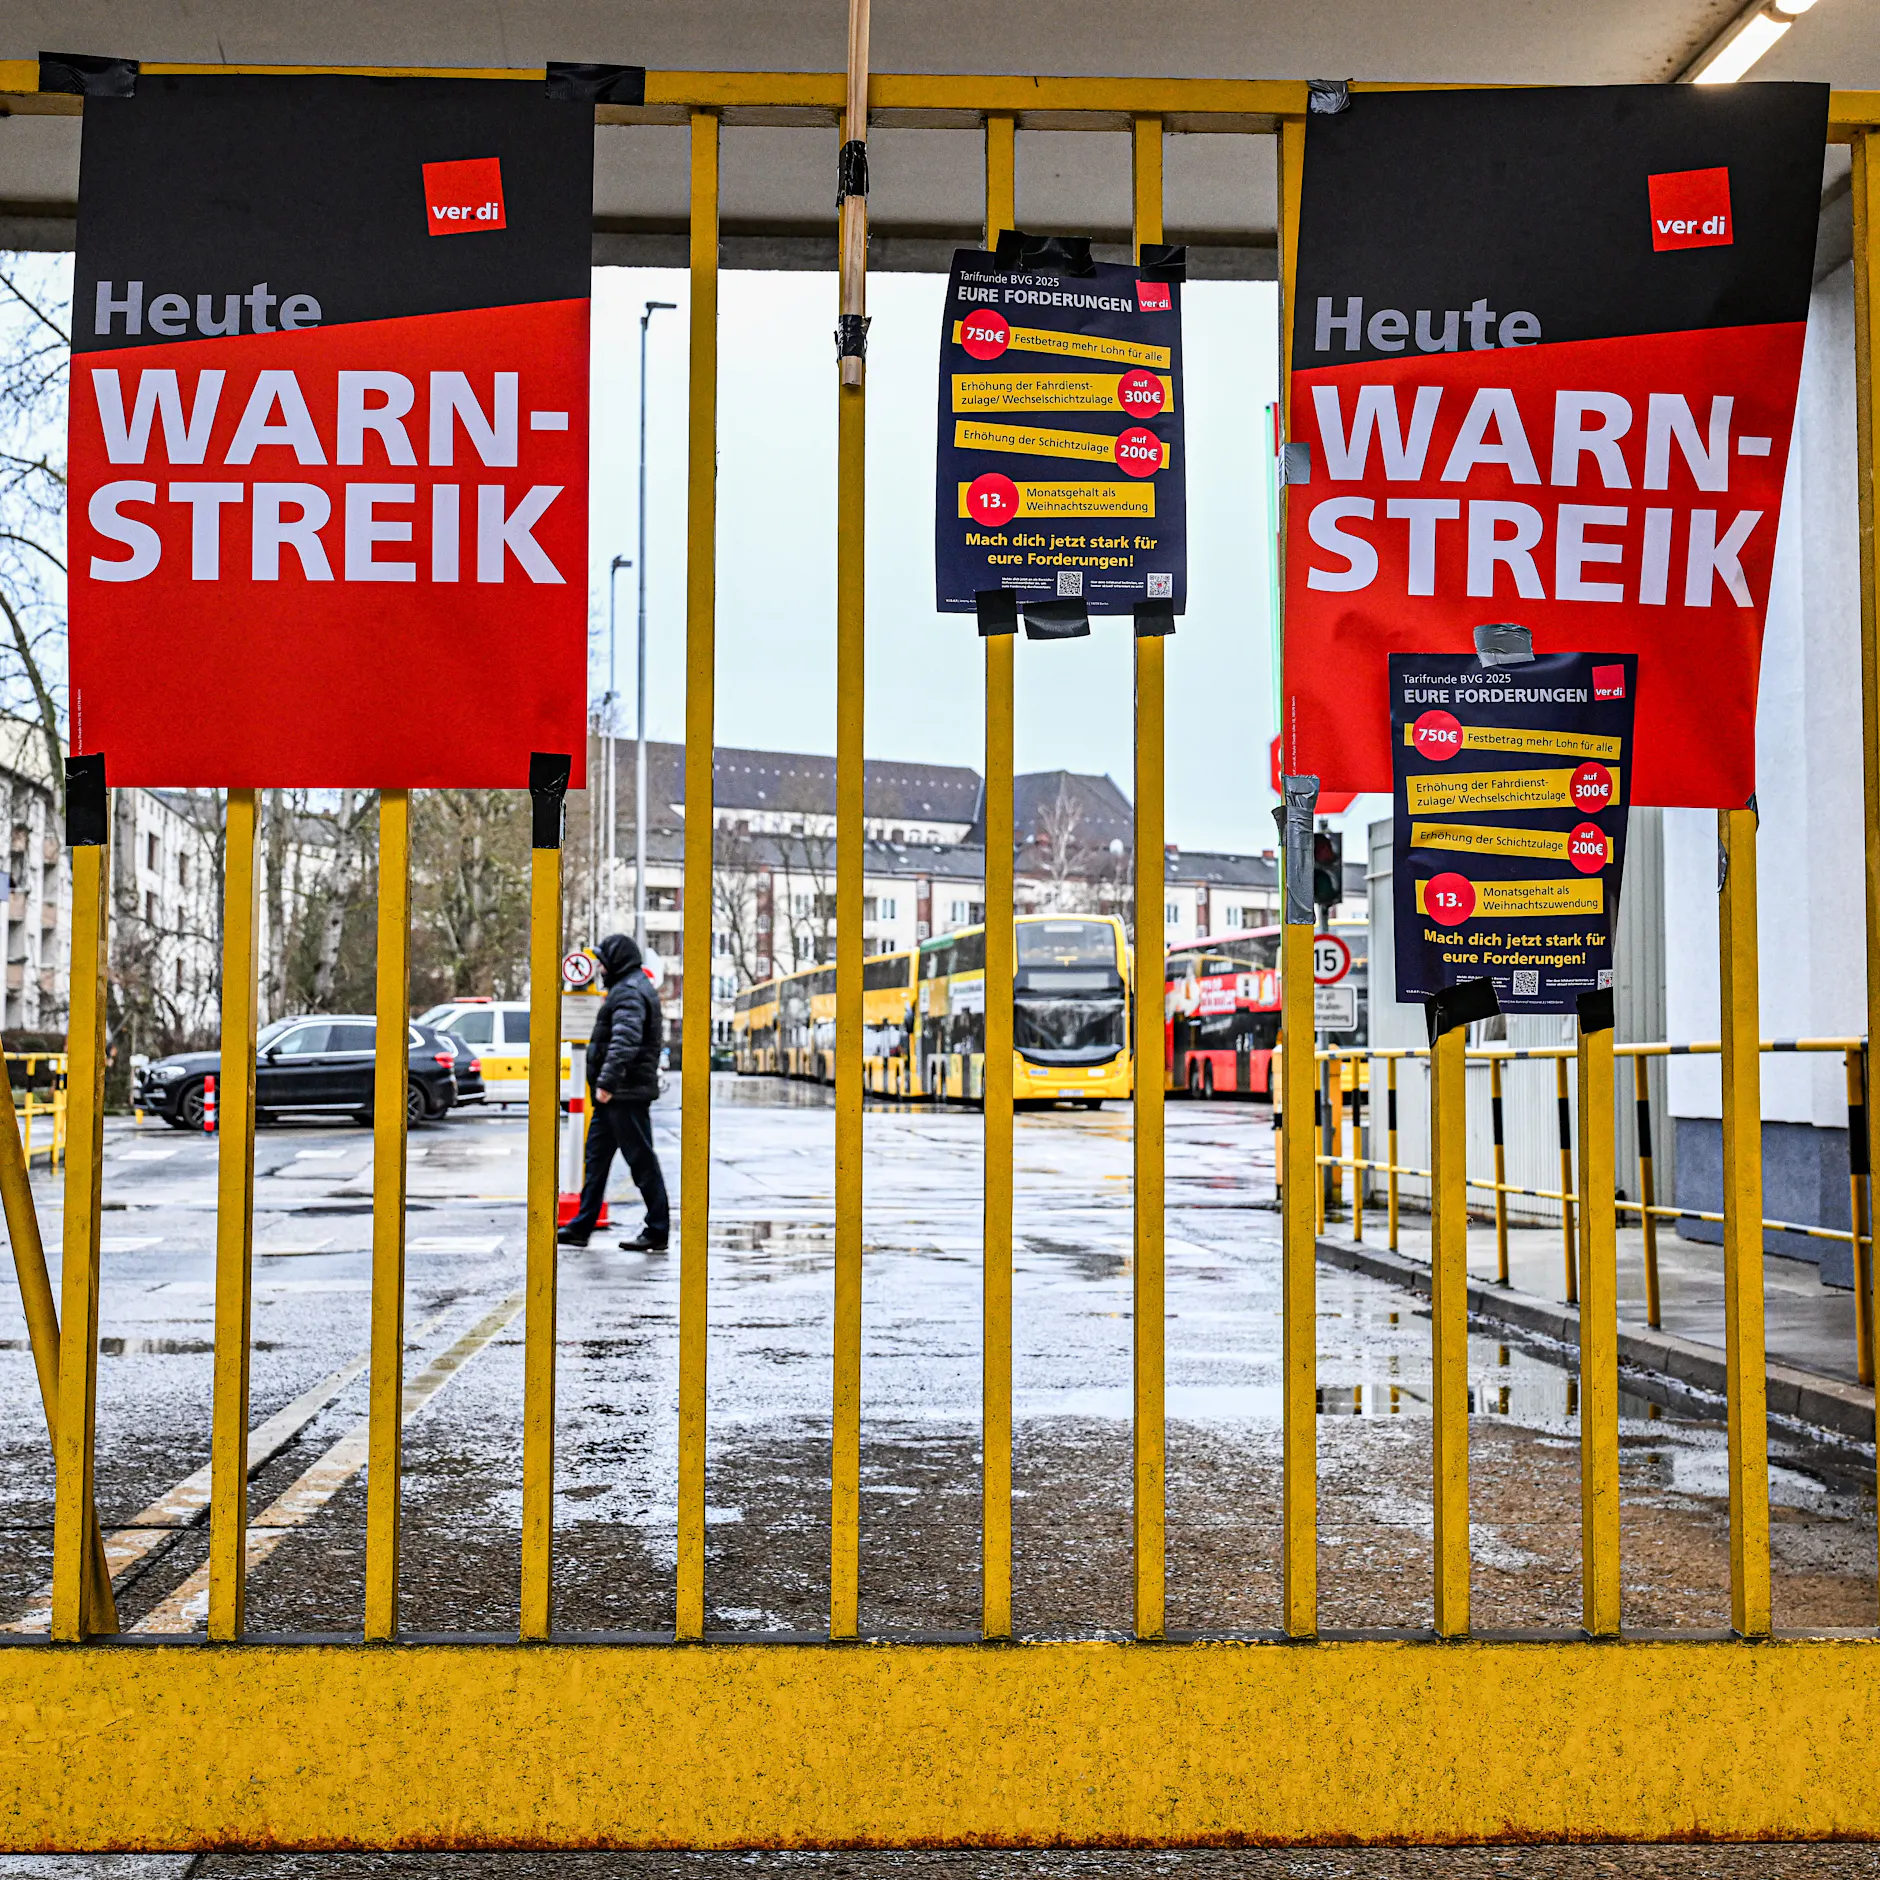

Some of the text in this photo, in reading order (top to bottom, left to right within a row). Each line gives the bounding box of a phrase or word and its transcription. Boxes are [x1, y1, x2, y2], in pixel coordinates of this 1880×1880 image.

[431, 200, 500, 223] ver.di
[1657, 215, 1726, 236] ver.di
[960, 270, 1060, 287] Tarifrunde BVG 2025
[957, 286, 1133, 312] EURE FORDERUNGEN
[95, 280, 323, 337] Heute
[1314, 296, 1542, 352] Heute
[966, 326, 1005, 343] 750€
[1014, 333, 1163, 362] Festbetrag mehr Lohn für alle
[961, 380, 1093, 394] Erhöhung der Fahrdienst-
[1132, 379, 1148, 389] auf
[961, 394, 1114, 407] zulage/ Wechselschichtzulage
[1124, 391, 1161, 404] 300€
[91, 369, 569, 468] WARN-
[964, 430, 1110, 454] Erhöhung der Schichtzulage
[1131, 435, 1147, 444] auf
[1311, 384, 1773, 493] WARN-
[1120, 445, 1158, 462] 200€
[980, 493, 1007, 508] 13.
[1026, 488, 1116, 500] Monatsgehalt als
[1026, 501, 1149, 514] Weihnachtszuwendung
[88, 481, 567, 585] STREIK
[965, 533, 1158, 551] Mach dich jetzt stark für
[987, 552, 1134, 570] eure Forderungen!
[1306, 496, 1765, 609] STREIK
[1402, 674, 1512, 684] Tarifrunde BVG 2025
[1404, 688, 1588, 704] EURE FORDERUNGEN
[1418, 728, 1458, 744] 750€
[1468, 733, 1614, 752] Festbetrag mehr Lohn für alle
[1583, 772, 1598, 782] auf
[1416, 778, 1549, 794] Erhöhung der Fahrdienst-
[1576, 784, 1609, 798] 300€
[1417, 790, 1566, 808] zulage/ Wechselschichtzulage
[1420, 831, 1564, 852] Erhöhung der Schichtzulage
[1580, 830, 1594, 840] auf
[1572, 841, 1604, 856] 200€
[1436, 892, 1463, 907] 13.
[1483, 885, 1570, 900] Monatsgehalt als
[1483, 898, 1599, 911] Weihnachtszuwendung
[1424, 929, 1606, 950] Mach dich jetzt stark für
[1314, 948, 1337, 972] 15
[1442, 952, 1586, 968] eure Forderungen!
